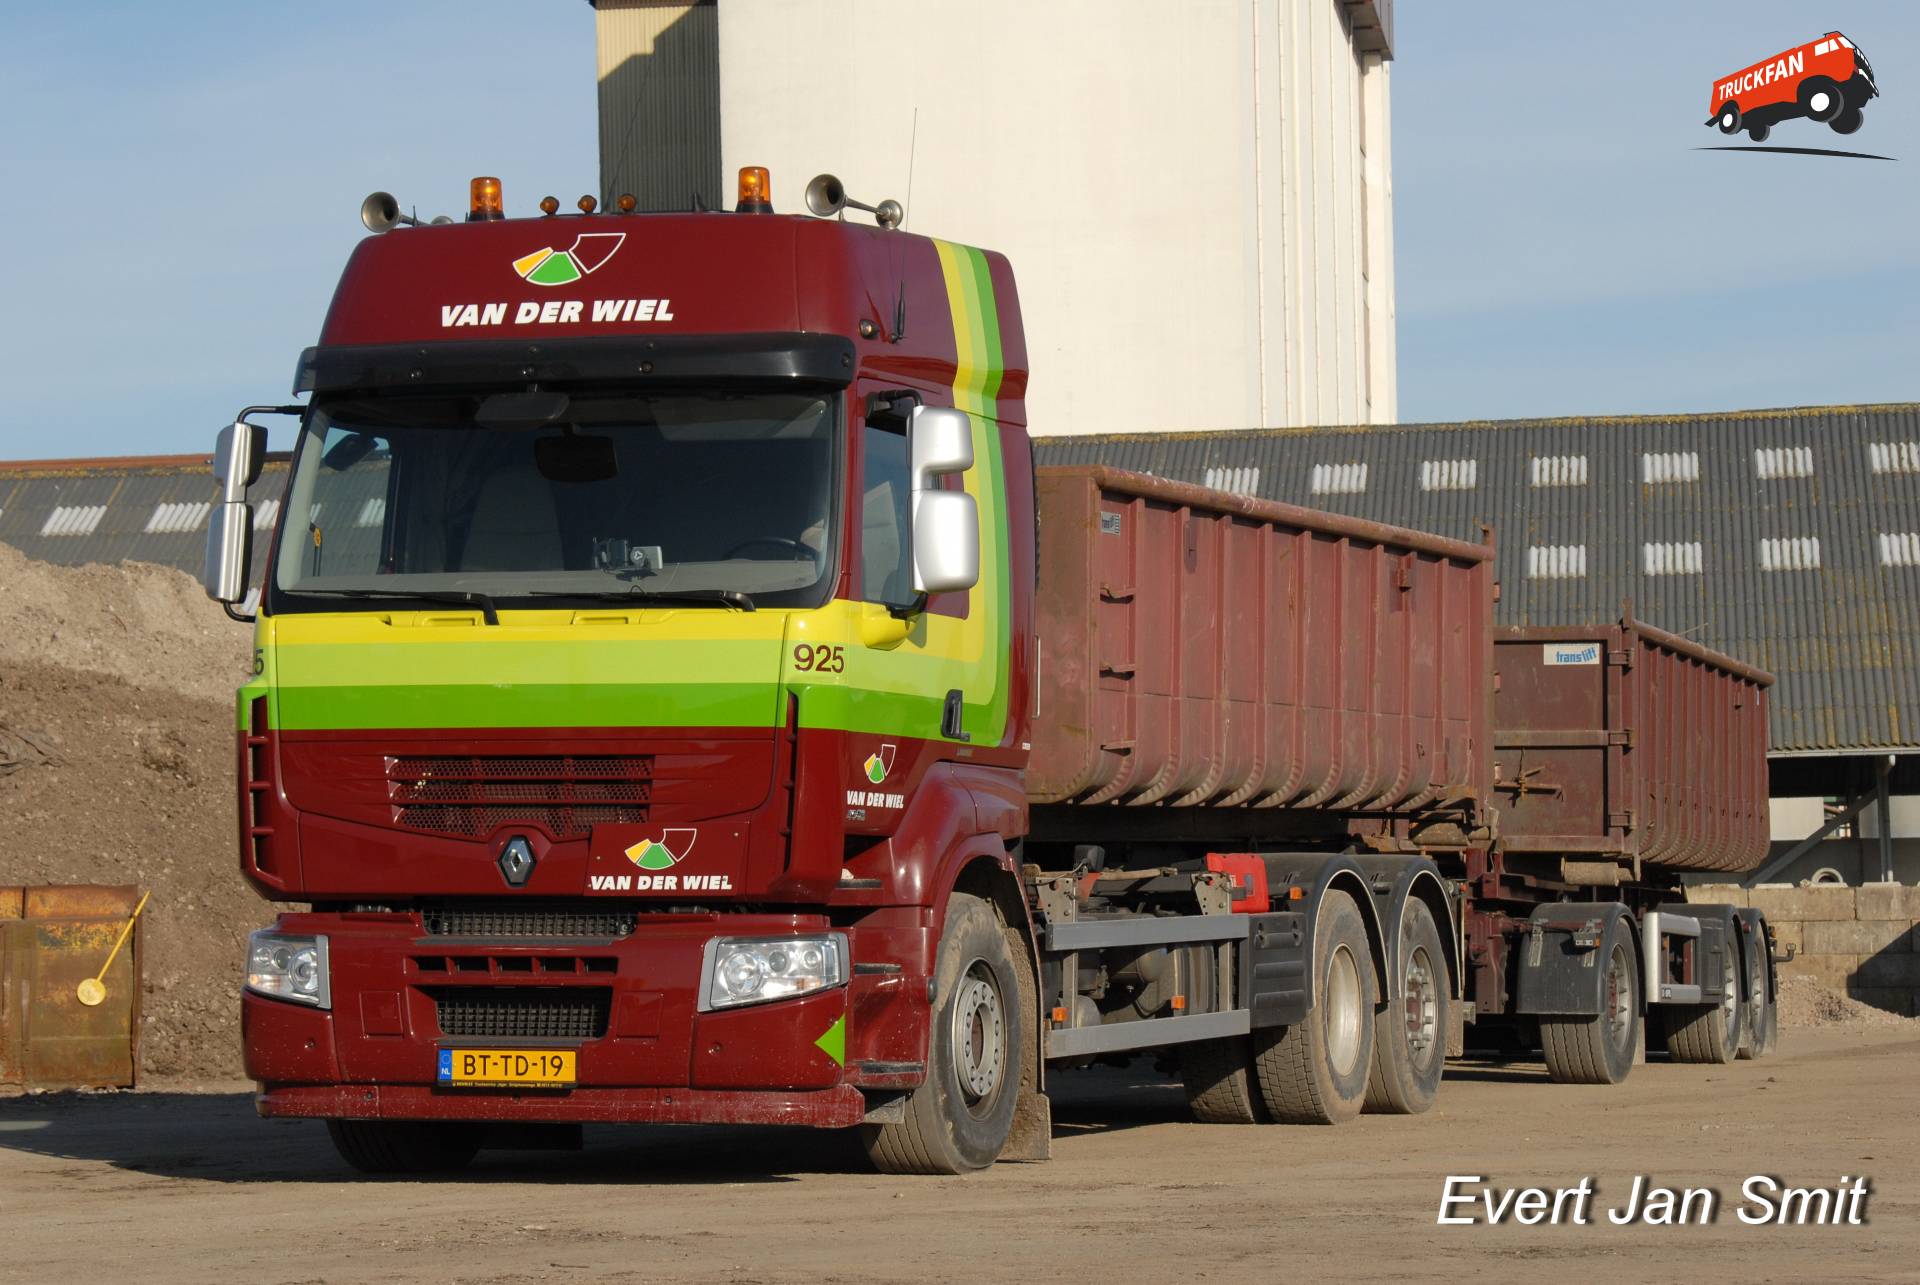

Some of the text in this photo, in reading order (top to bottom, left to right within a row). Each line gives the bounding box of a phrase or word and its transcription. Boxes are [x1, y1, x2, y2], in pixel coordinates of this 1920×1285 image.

[441, 299, 674, 327] VAN DER WIEL
[794, 644, 844, 673] 925
[847, 790, 904, 809] VAN DER WIEL
[590, 875, 733, 890] VAN DER WIEL
[441, 1067, 450, 1075] NL
[463, 1054, 563, 1077] BT-TD-19
